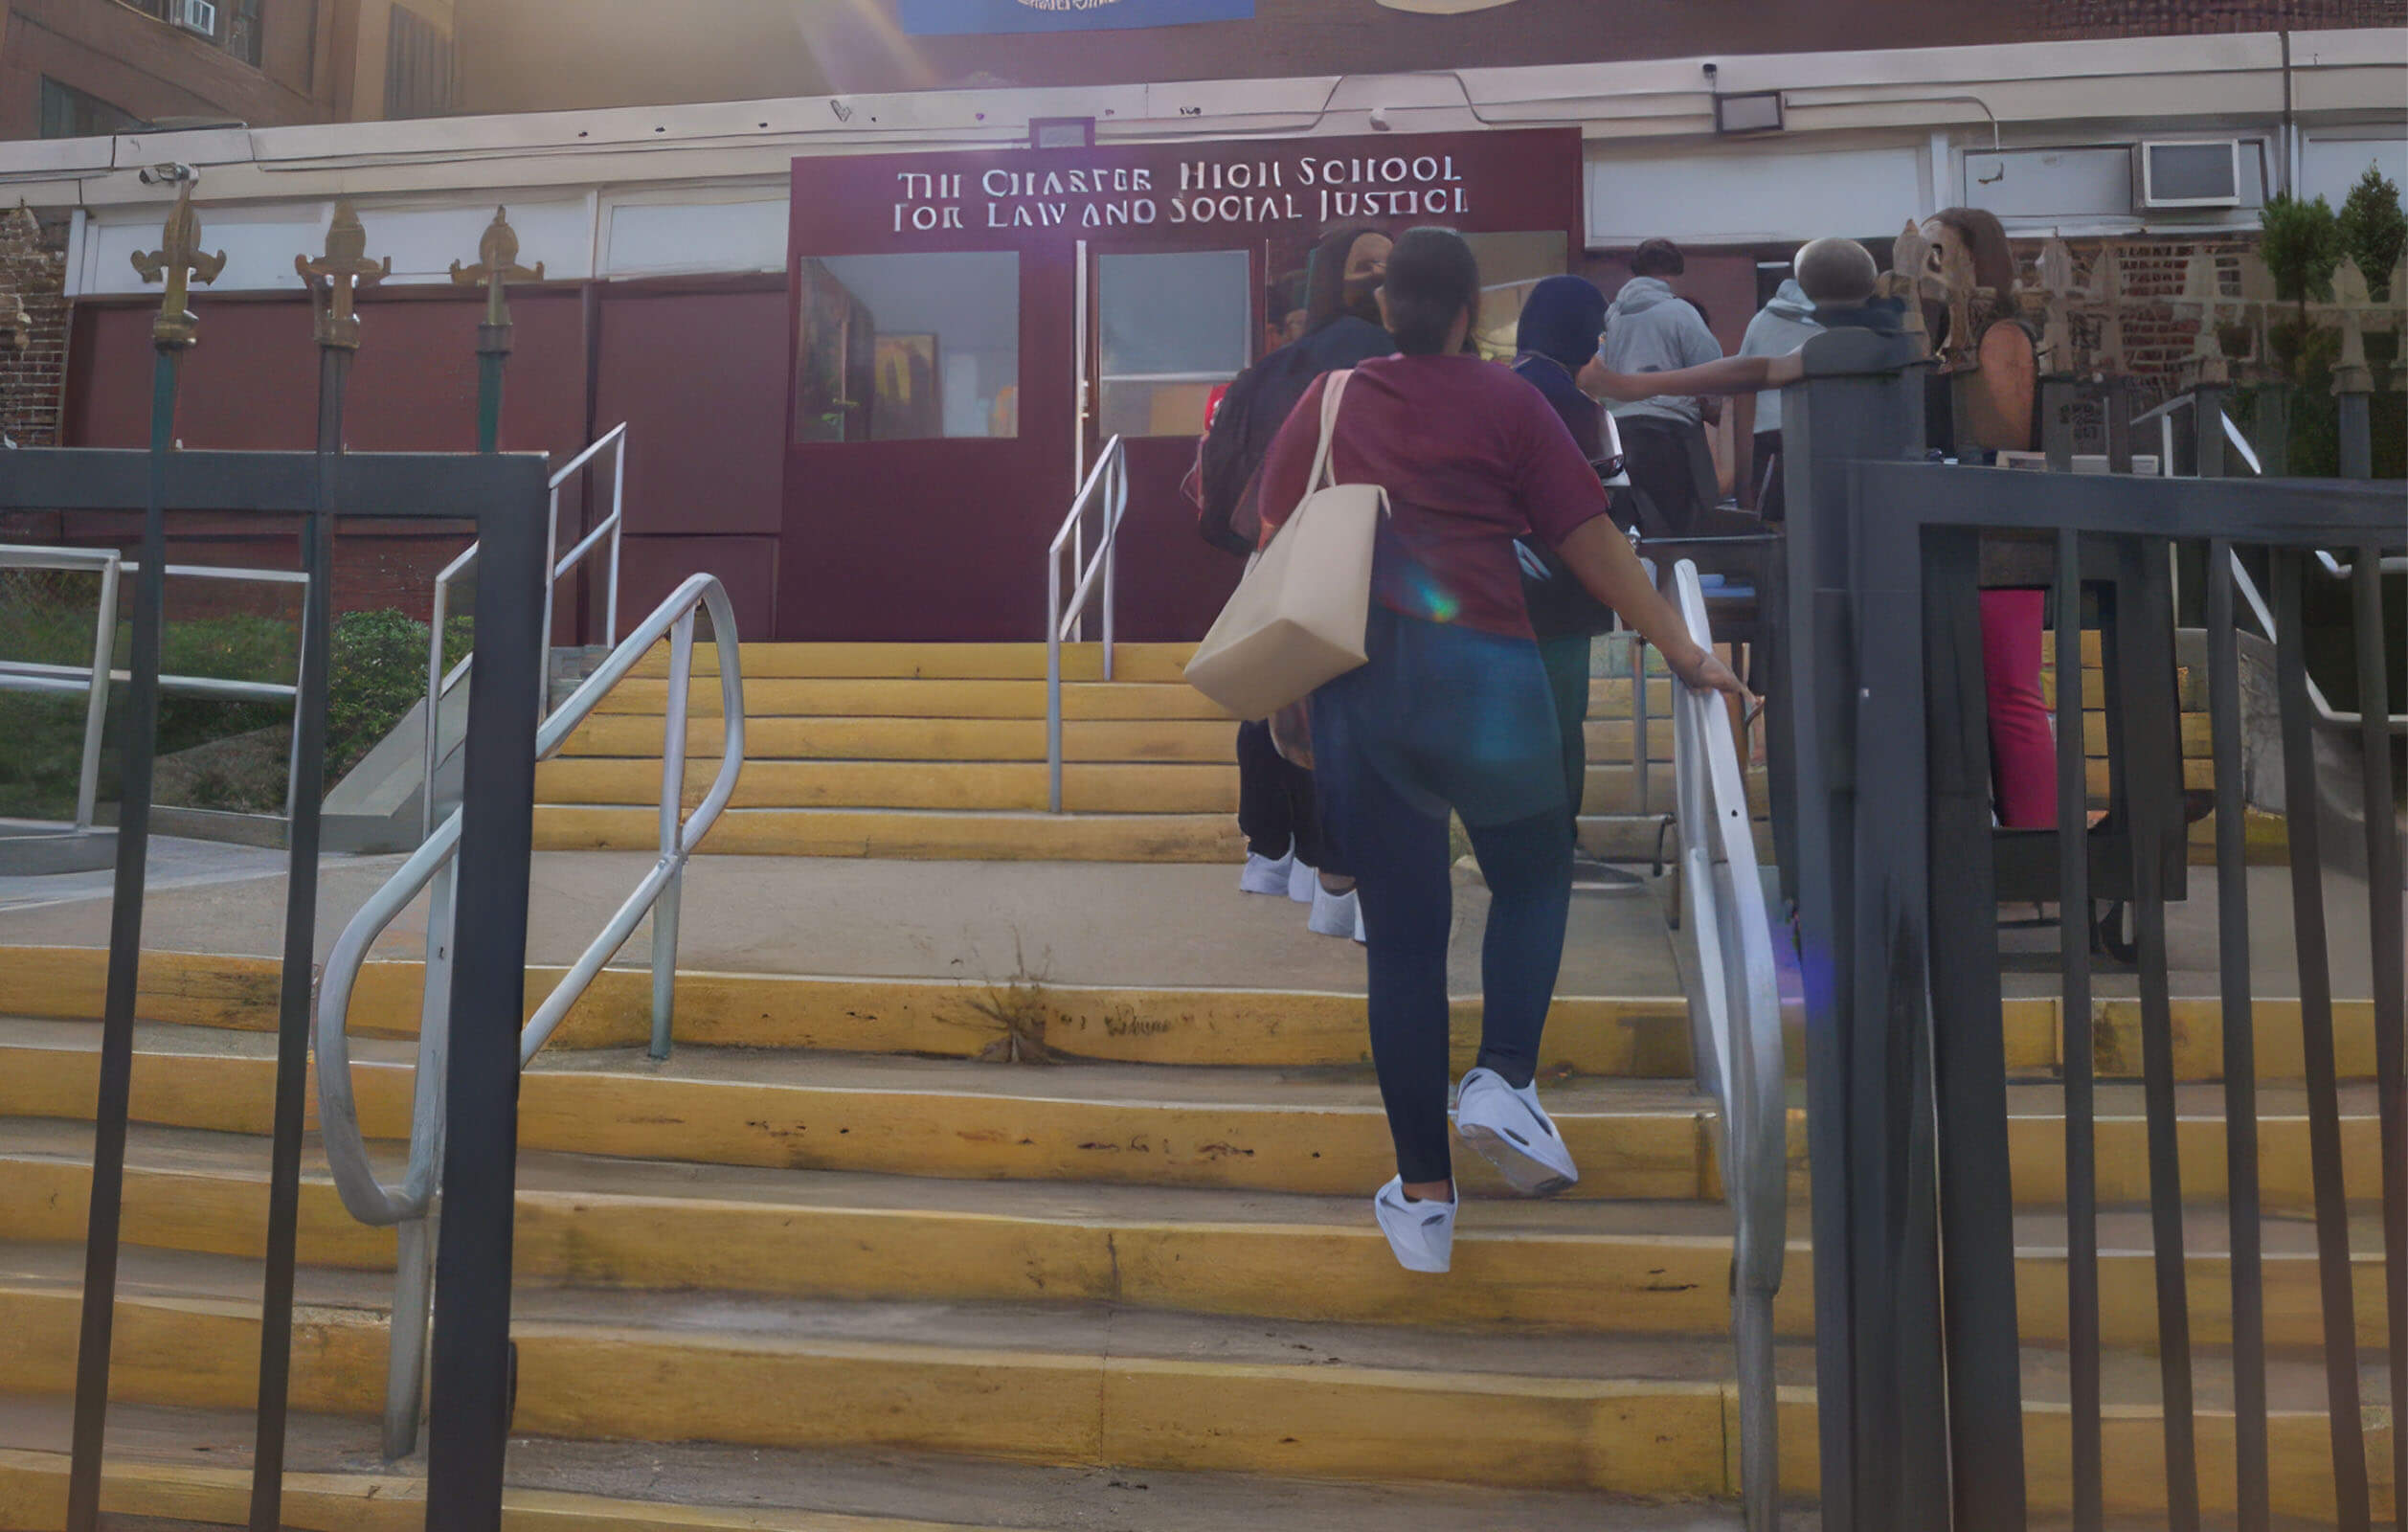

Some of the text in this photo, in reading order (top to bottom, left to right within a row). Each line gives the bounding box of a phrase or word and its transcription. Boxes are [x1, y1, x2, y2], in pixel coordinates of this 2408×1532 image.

[1295, 155, 1463, 186] SCHOOL
[893, 202, 964, 233] FOR
[986, 201, 1068, 228] LAW
[1080, 197, 1158, 229] AND
[1168, 192, 1303, 224] SOCIAL
